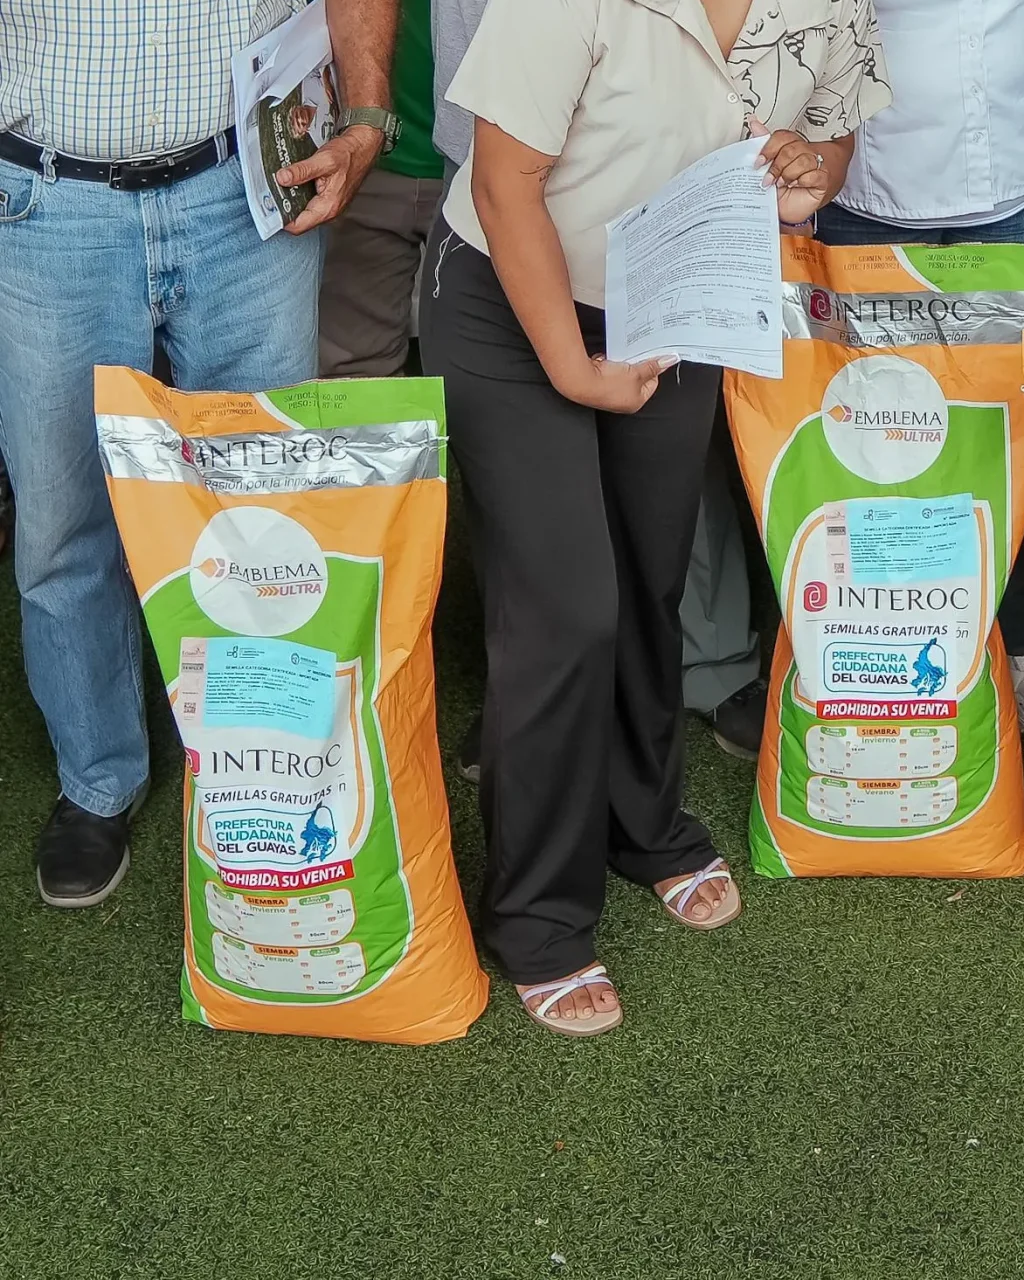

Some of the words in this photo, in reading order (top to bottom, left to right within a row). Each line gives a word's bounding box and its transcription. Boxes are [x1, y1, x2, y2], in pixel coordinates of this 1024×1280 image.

[834, 299, 973, 322] INTEROC
[875, 333, 895, 344] por
[897, 333, 907, 341] la
[855, 410, 943, 425] EMBLEMA
[903, 430, 941, 442] ULTRA
[246, 479, 267, 492] por
[270, 477, 282, 489] la
[229, 561, 321, 582] EMBLEMA
[279, 584, 322, 596] ULTRA
[838, 586, 969, 611] INTEROC
[824, 624, 879, 635] SEMILLAS
[882, 625, 948, 636] GRATUITAS
[832, 652, 908, 662] PREFECTURA
[832, 662, 908, 673] CIUDADANA
[832, 674, 856, 683] DEL
[859, 674, 908, 685] GUAYAS
[823, 703, 888, 716] PROHIBIDA
[890, 704, 908, 716] SU
[909, 704, 949, 716] VENTA
[212, 743, 342, 778] INTEROC
[204, 789, 267, 804] SEMILLAS
[270, 784, 332, 805] GRATUITAS
[215, 818, 294, 831] PREFECTURA
[216, 830, 295, 843] CIUDADANA
[217, 843, 243, 854] DEL
[246, 842, 297, 856] GUAYAS
[282, 875, 299, 887] SU
[301, 865, 345, 884] VENTA
[247, 897, 285, 905] SIEMBRA
[263, 955, 294, 963] Verano
